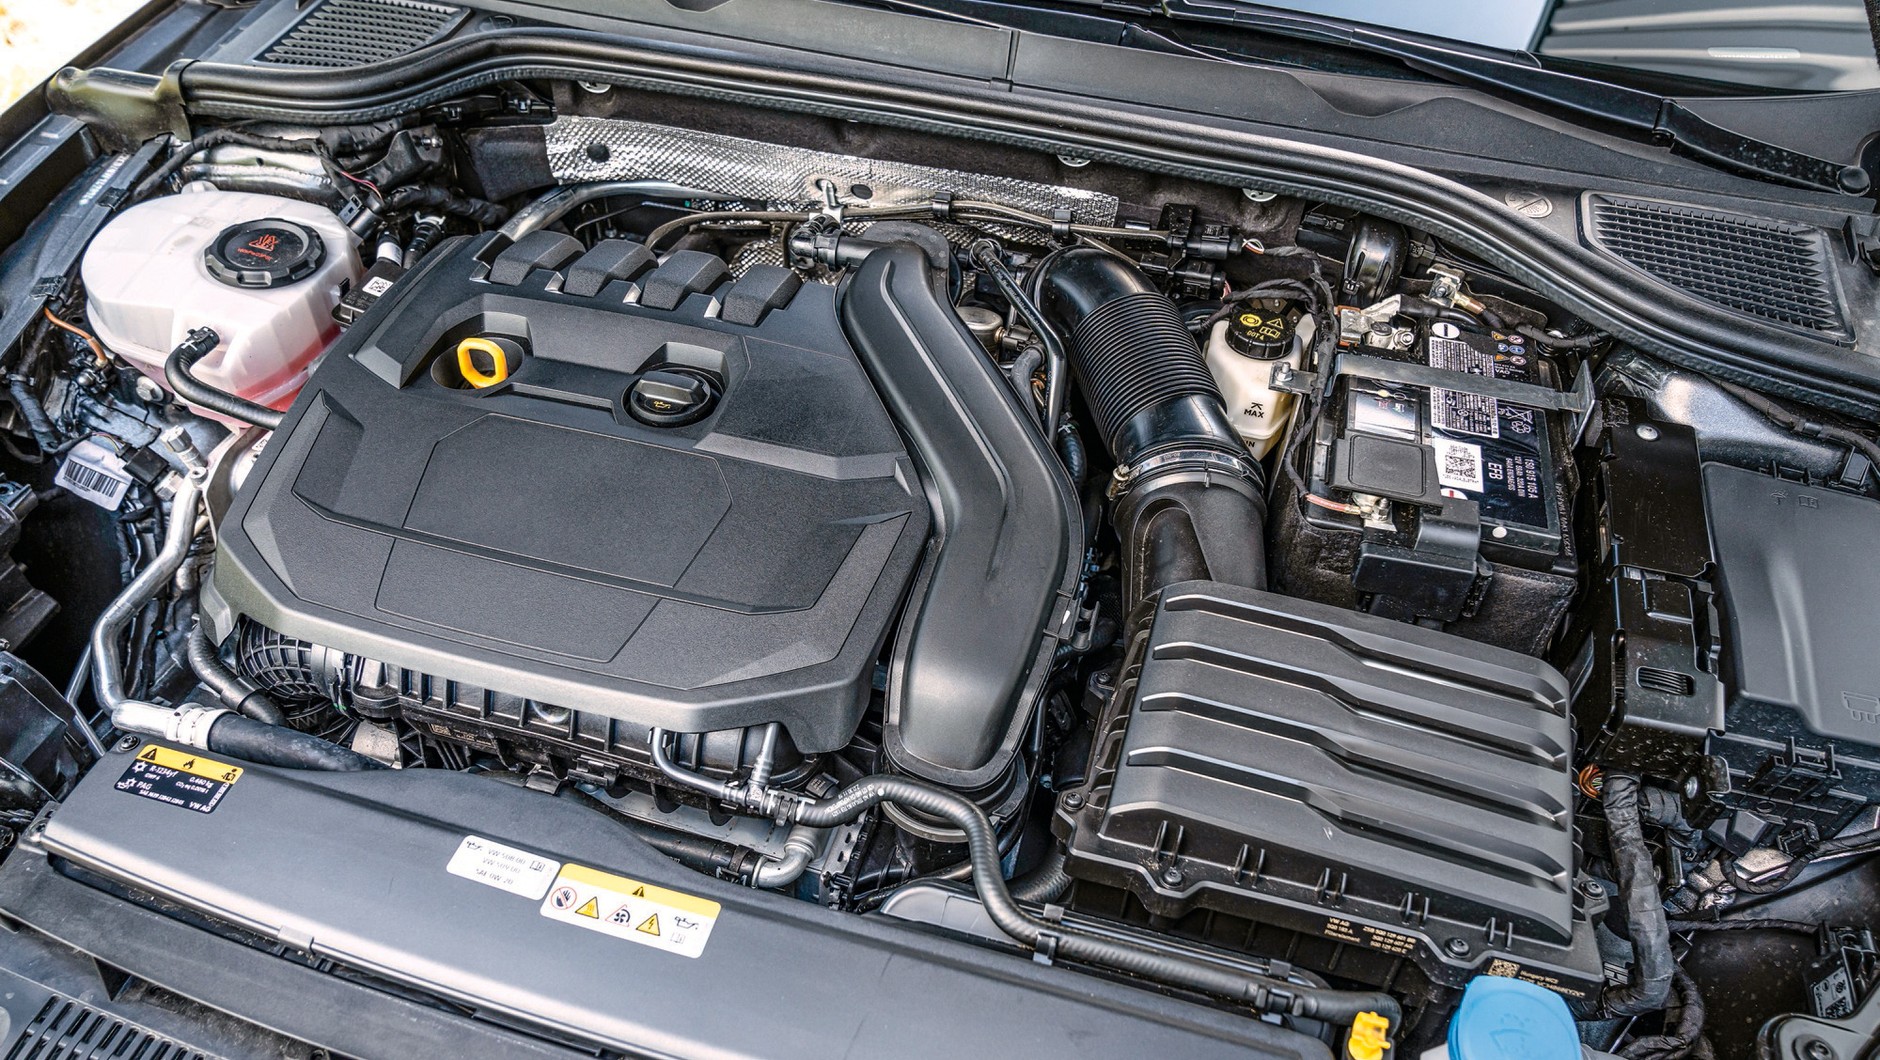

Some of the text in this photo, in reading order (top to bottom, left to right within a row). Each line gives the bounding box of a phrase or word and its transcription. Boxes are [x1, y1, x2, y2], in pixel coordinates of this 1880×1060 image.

[1246, 330, 1260, 340] DOT
[1243, 408, 1265, 418] MAX
[1514, 455, 1523, 465] 12V
[1487, 461, 1504, 480] EFB
[1525, 469, 1537, 482] 915
[1527, 482, 1538, 493] 105
[149, 764, 179, 778] R-1234yf
[136, 781, 153, 791] PAG
[189, 800, 212, 813] VW AG
[488, 848, 501, 857] VW
[482, 857, 495, 866] VW
